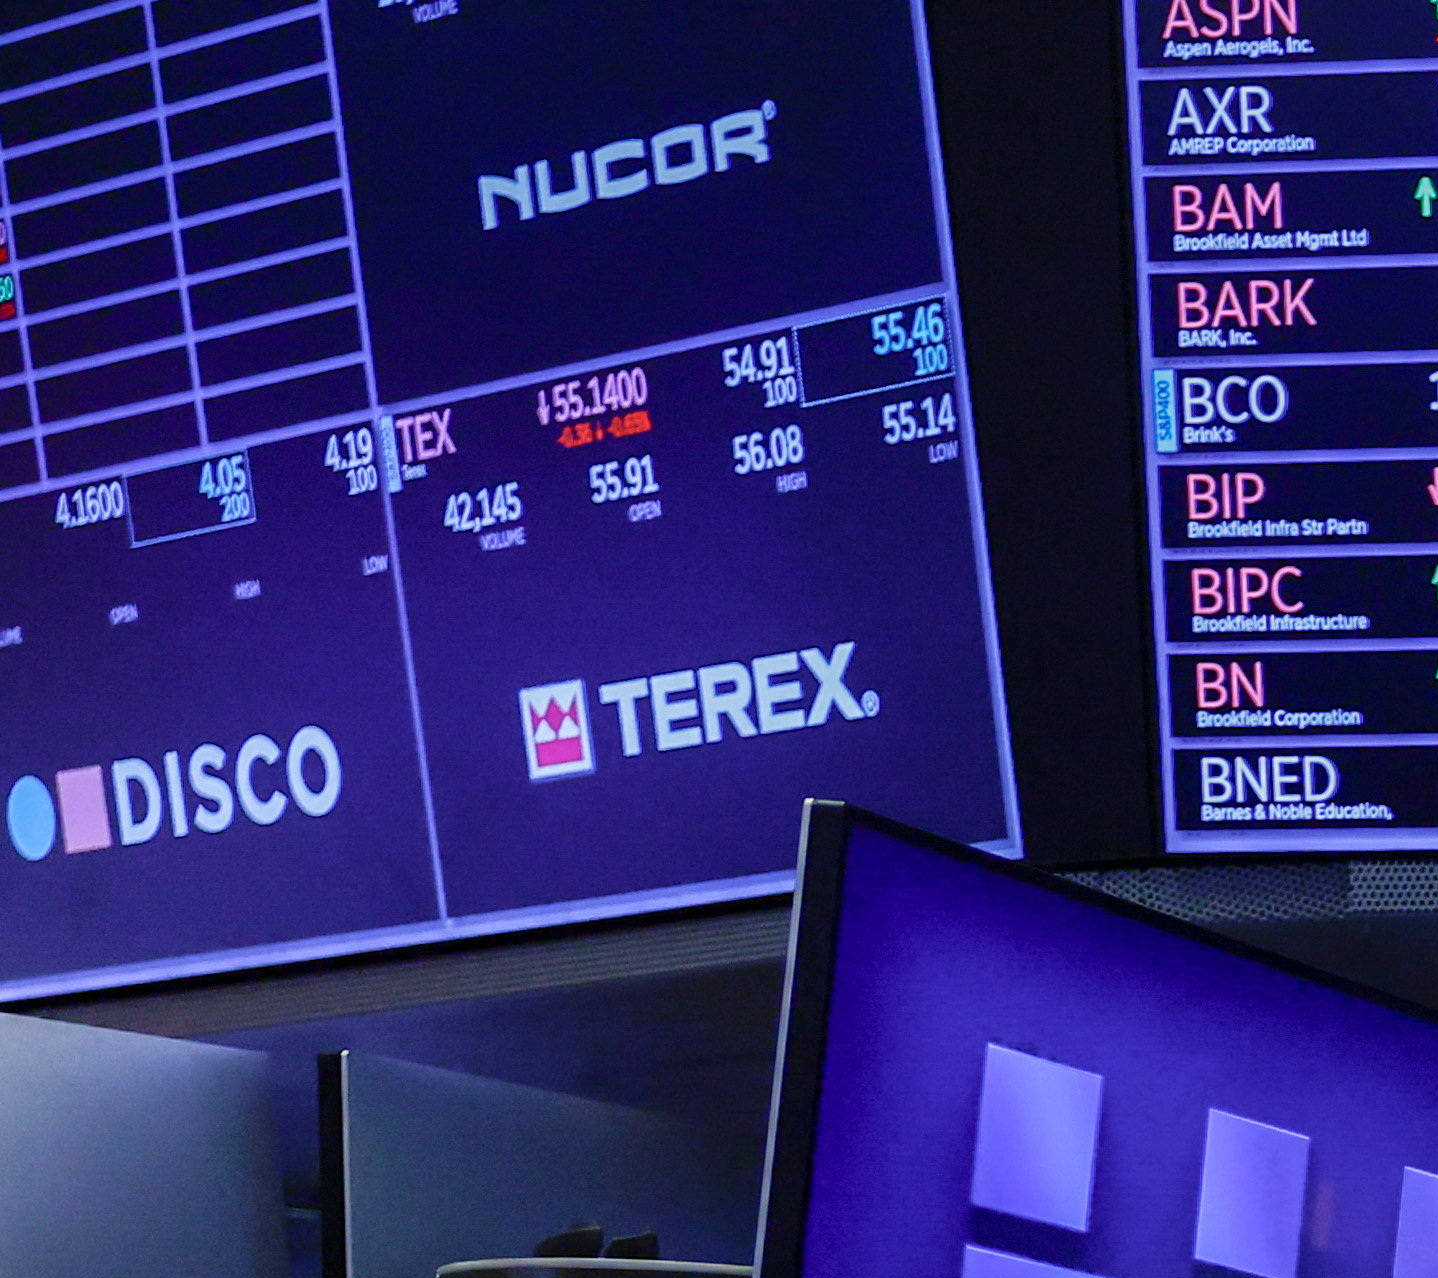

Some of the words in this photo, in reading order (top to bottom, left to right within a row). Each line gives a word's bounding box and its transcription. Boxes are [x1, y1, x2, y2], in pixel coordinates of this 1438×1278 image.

[1162, 0, 1298, 40] ASPN
[1163, 40, 1212, 61] Aspen
[1285, 35, 1315, 54] Inc.
[1167, 85, 1273, 136] AXR
[477, 107, 771, 231] NUCOR
[1172, 181, 1283, 233] BAM
[1177, 278, 1318, 329] BARK
[871, 302, 946, 356] 55.46
[721, 336, 796, 390] 54.91
[551, 368, 649, 423] 55.1400
[880, 393, 957, 443] 55.14
[1182, 374, 1286, 425] BCO
[322, 427, 374, 474] 4.19
[396, 409, 457, 464] TEX
[732, 424, 804, 474] 56.08
[927, 441, 959, 465] LOW
[199, 455, 248, 499] 4.05
[590, 455, 660, 503] 55.91
[776, 469, 809, 493] HIGH
[1186, 472, 1266, 521] BIP
[54, 480, 126, 529] 4.1600
[443, 482, 523, 534] 42,145
[628, 499, 664, 523] OPEN
[480, 526, 528, 551] VOLUME
[1190, 565, 1304, 615] BIPC
[599, 640, 867, 757] TEREX
[1195, 661, 1265, 709] BN
[113, 724, 343, 846] DISCO
[1200, 755, 1337, 804] BNED
